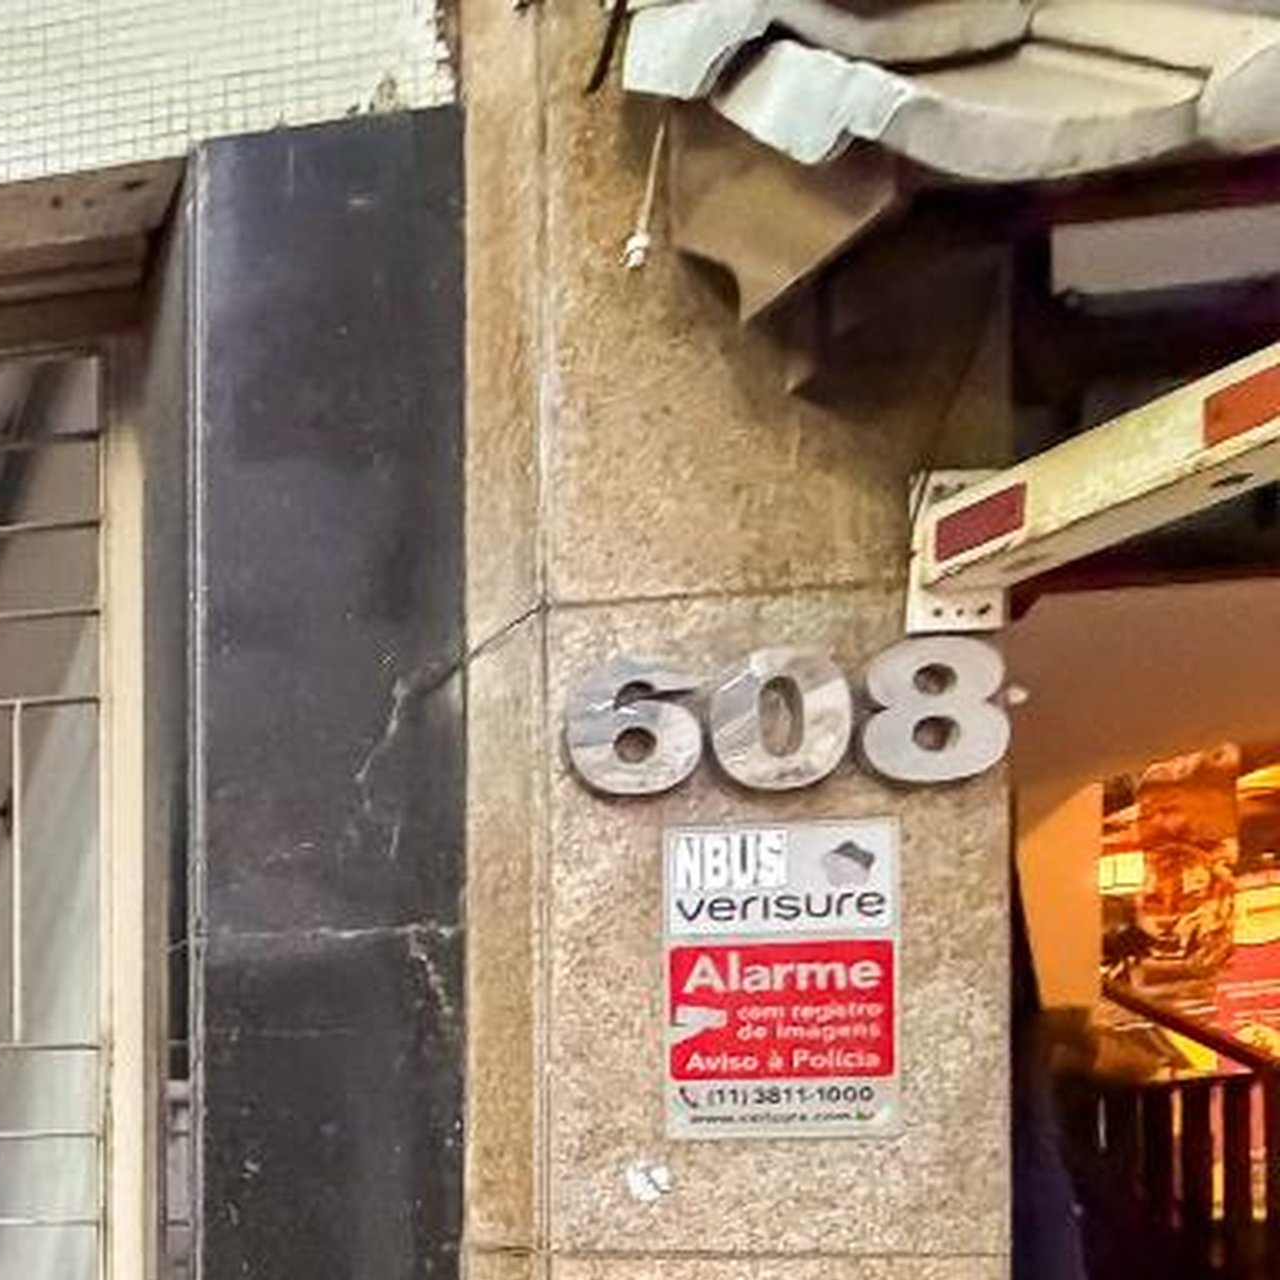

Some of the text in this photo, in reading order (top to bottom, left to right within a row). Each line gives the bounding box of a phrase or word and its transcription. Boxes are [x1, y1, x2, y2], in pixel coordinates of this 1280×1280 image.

[567, 635, 1012, 797] 608
[676, 891, 887, 921] verisure
[683, 951, 883, 994] Alarme
[737, 1002, 883, 1023] com registro
[736, 1023, 769, 1041] de
[686, 1052, 759, 1072] Aviso
[768, 1050, 784, 1070] à
